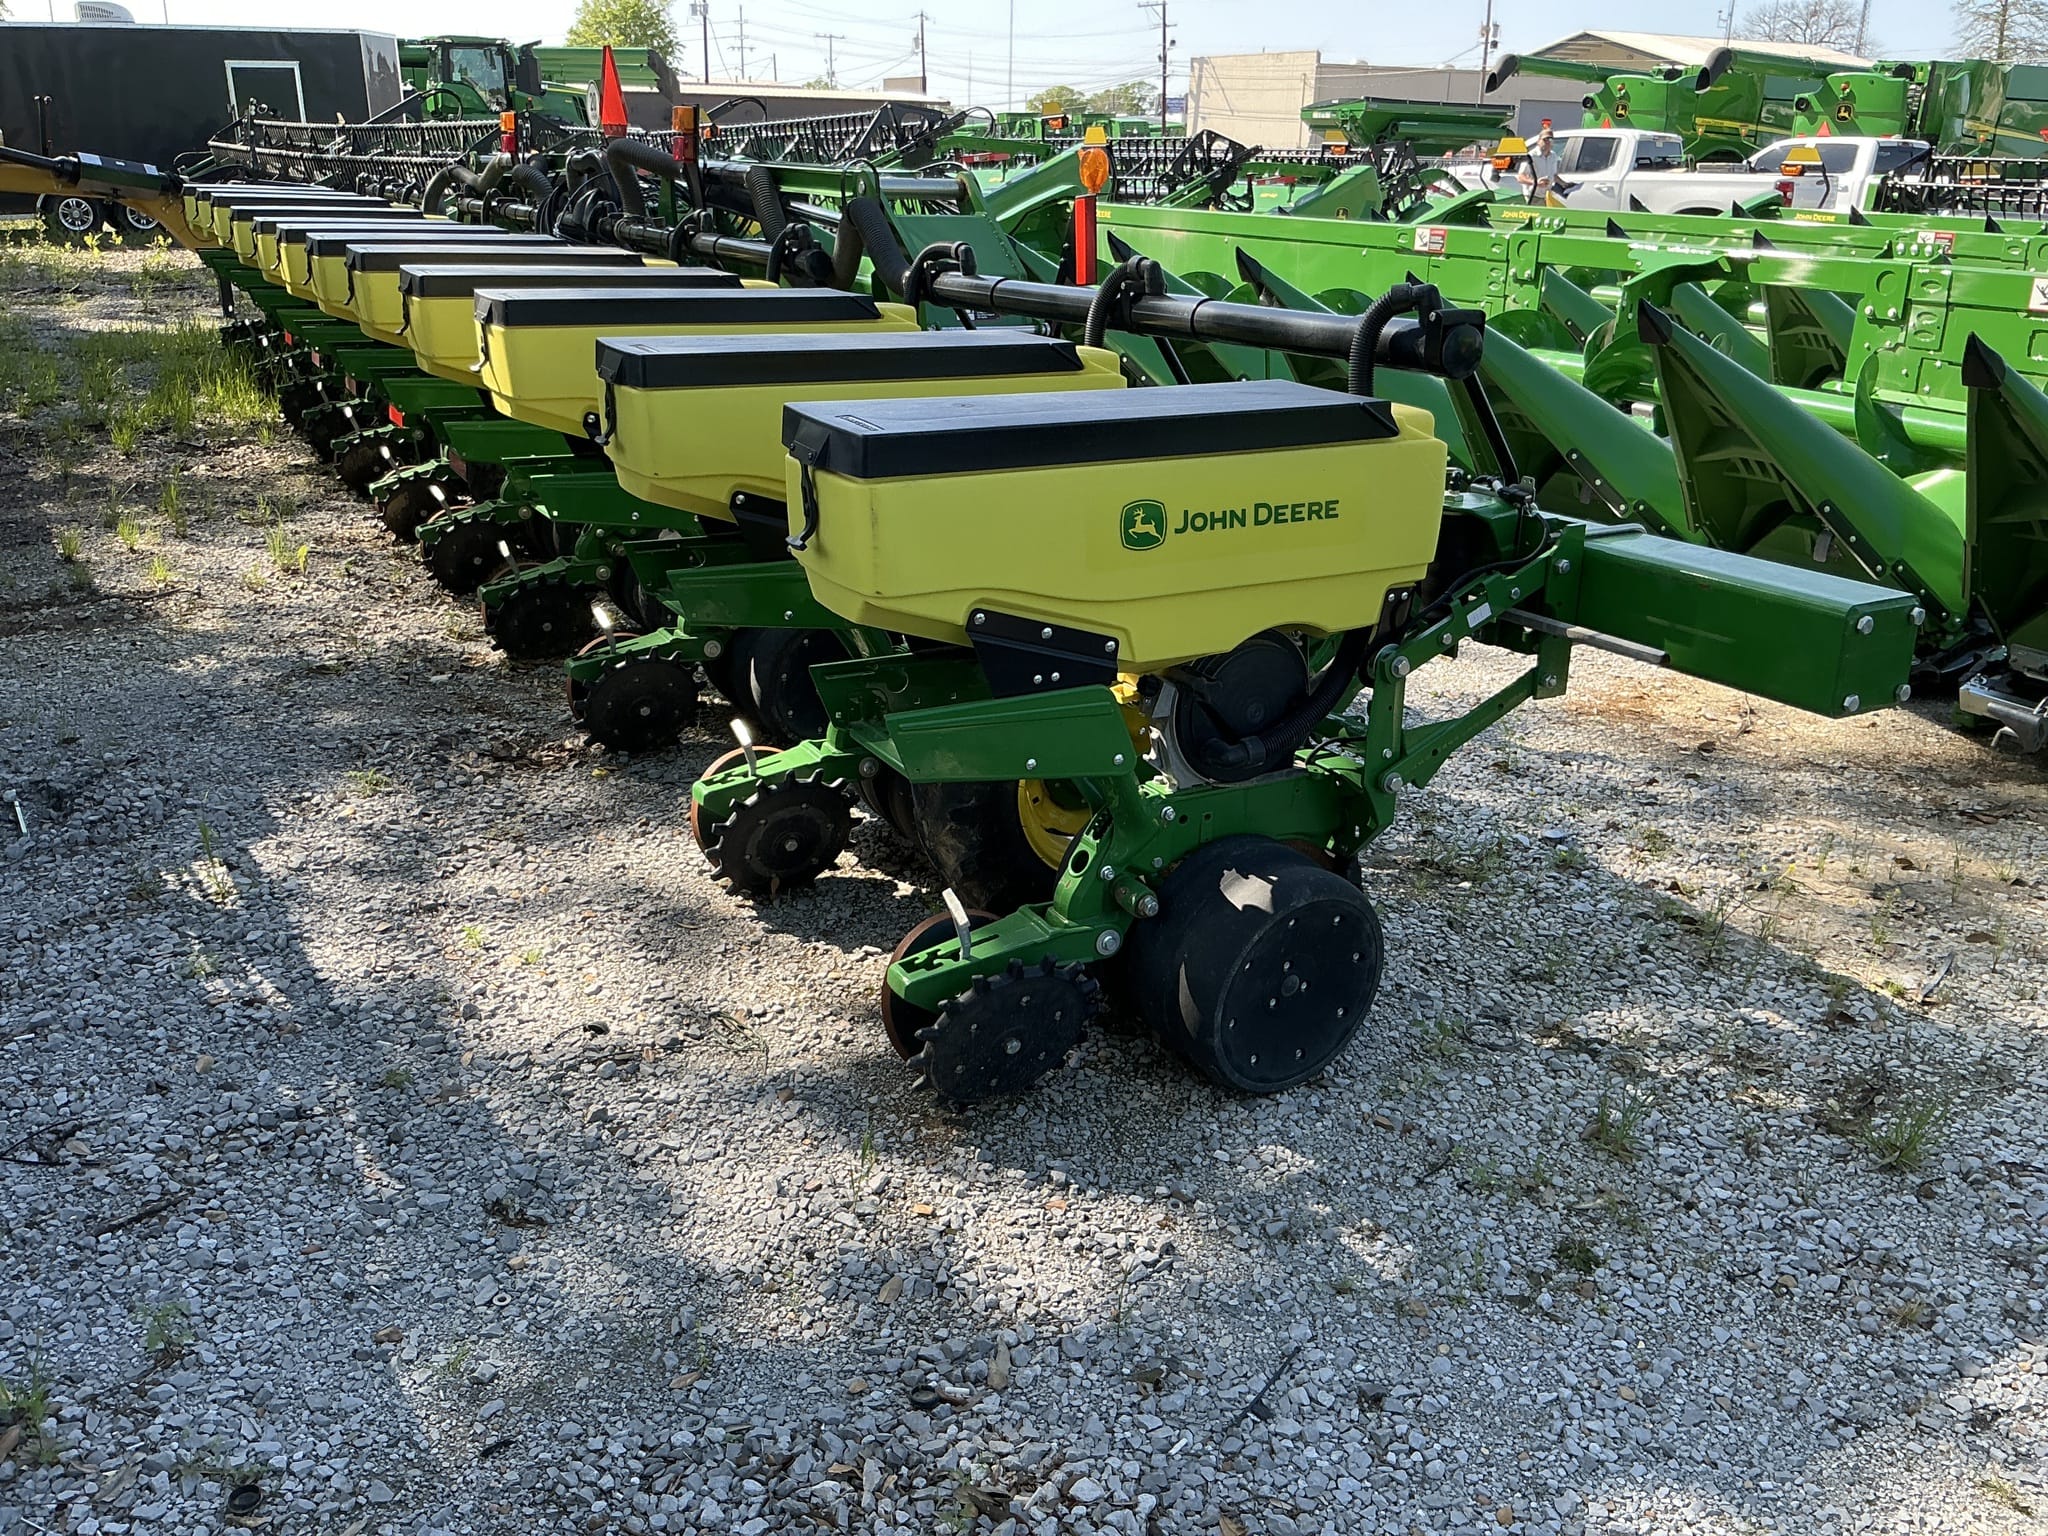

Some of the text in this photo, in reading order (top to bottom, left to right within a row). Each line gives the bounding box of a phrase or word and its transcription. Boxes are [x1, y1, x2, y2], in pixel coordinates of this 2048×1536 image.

[1794, 212, 1836, 222] JOHN DEERE
[1174, 499, 1340, 534] JOHN DEERE
